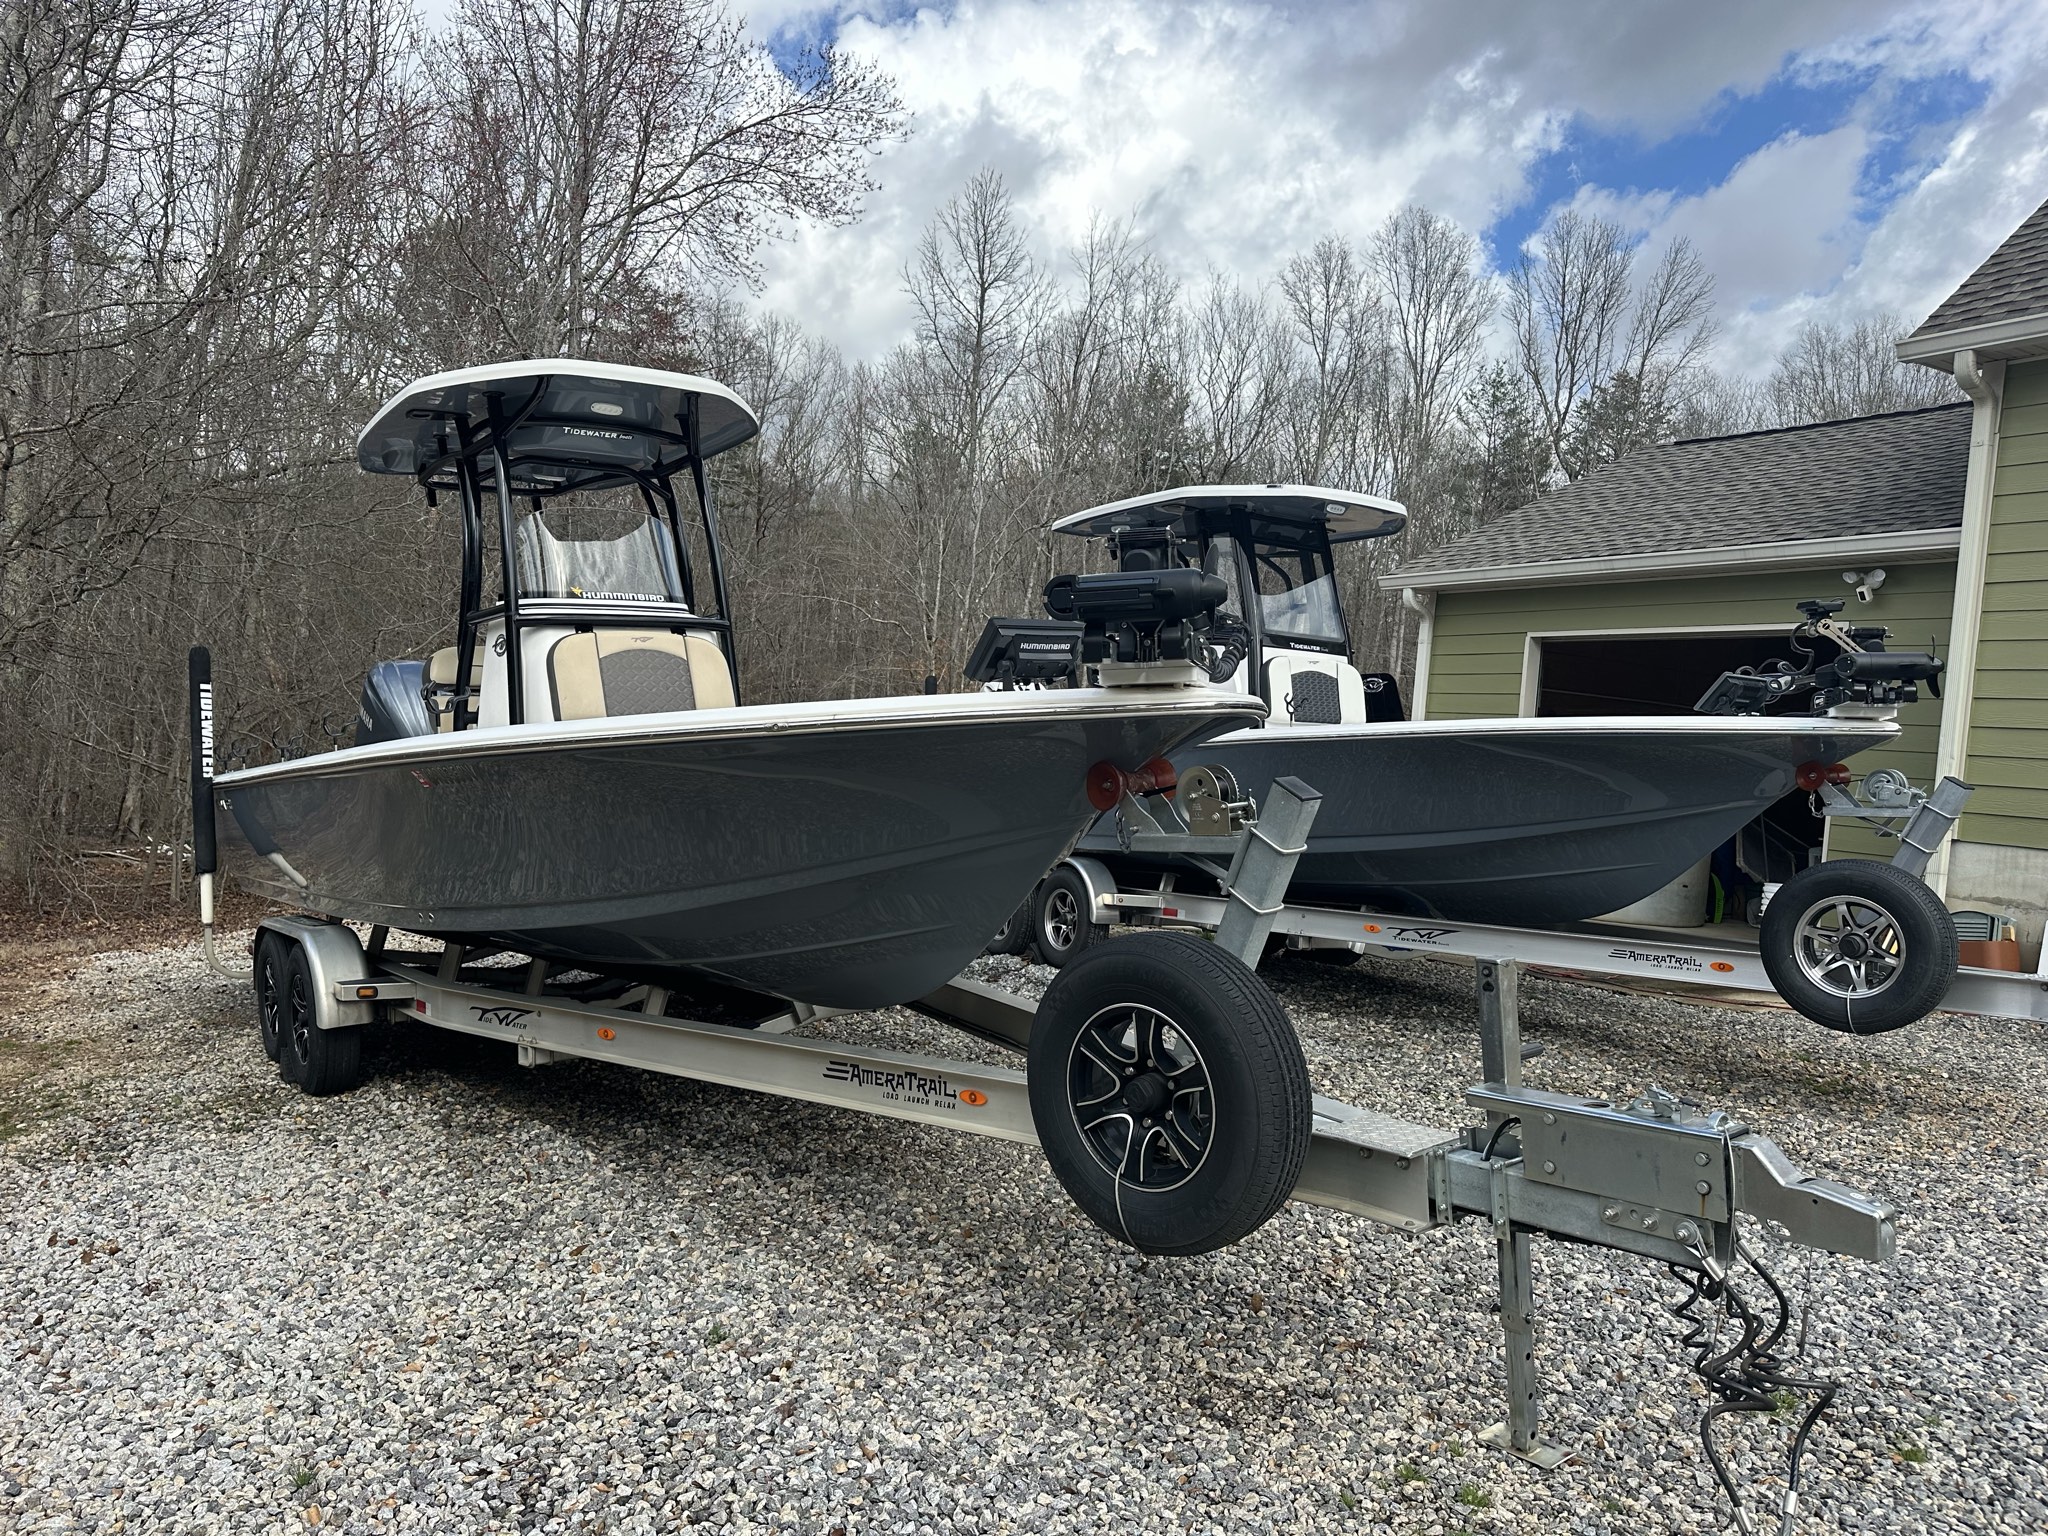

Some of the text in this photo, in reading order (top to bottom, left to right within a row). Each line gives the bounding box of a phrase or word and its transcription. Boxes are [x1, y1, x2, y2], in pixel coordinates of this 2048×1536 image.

[562, 426, 617, 439] TIDEWATER
[582, 591, 665, 602] HUMMINBIRD
[1020, 642, 1071, 650] HUMMINBIRD
[199, 682, 214, 779] TIDEWATER
[1392, 935, 1437, 945] TIDEWATER
[882, 1091, 957, 1110] LOAD LAUNCH RELAX
